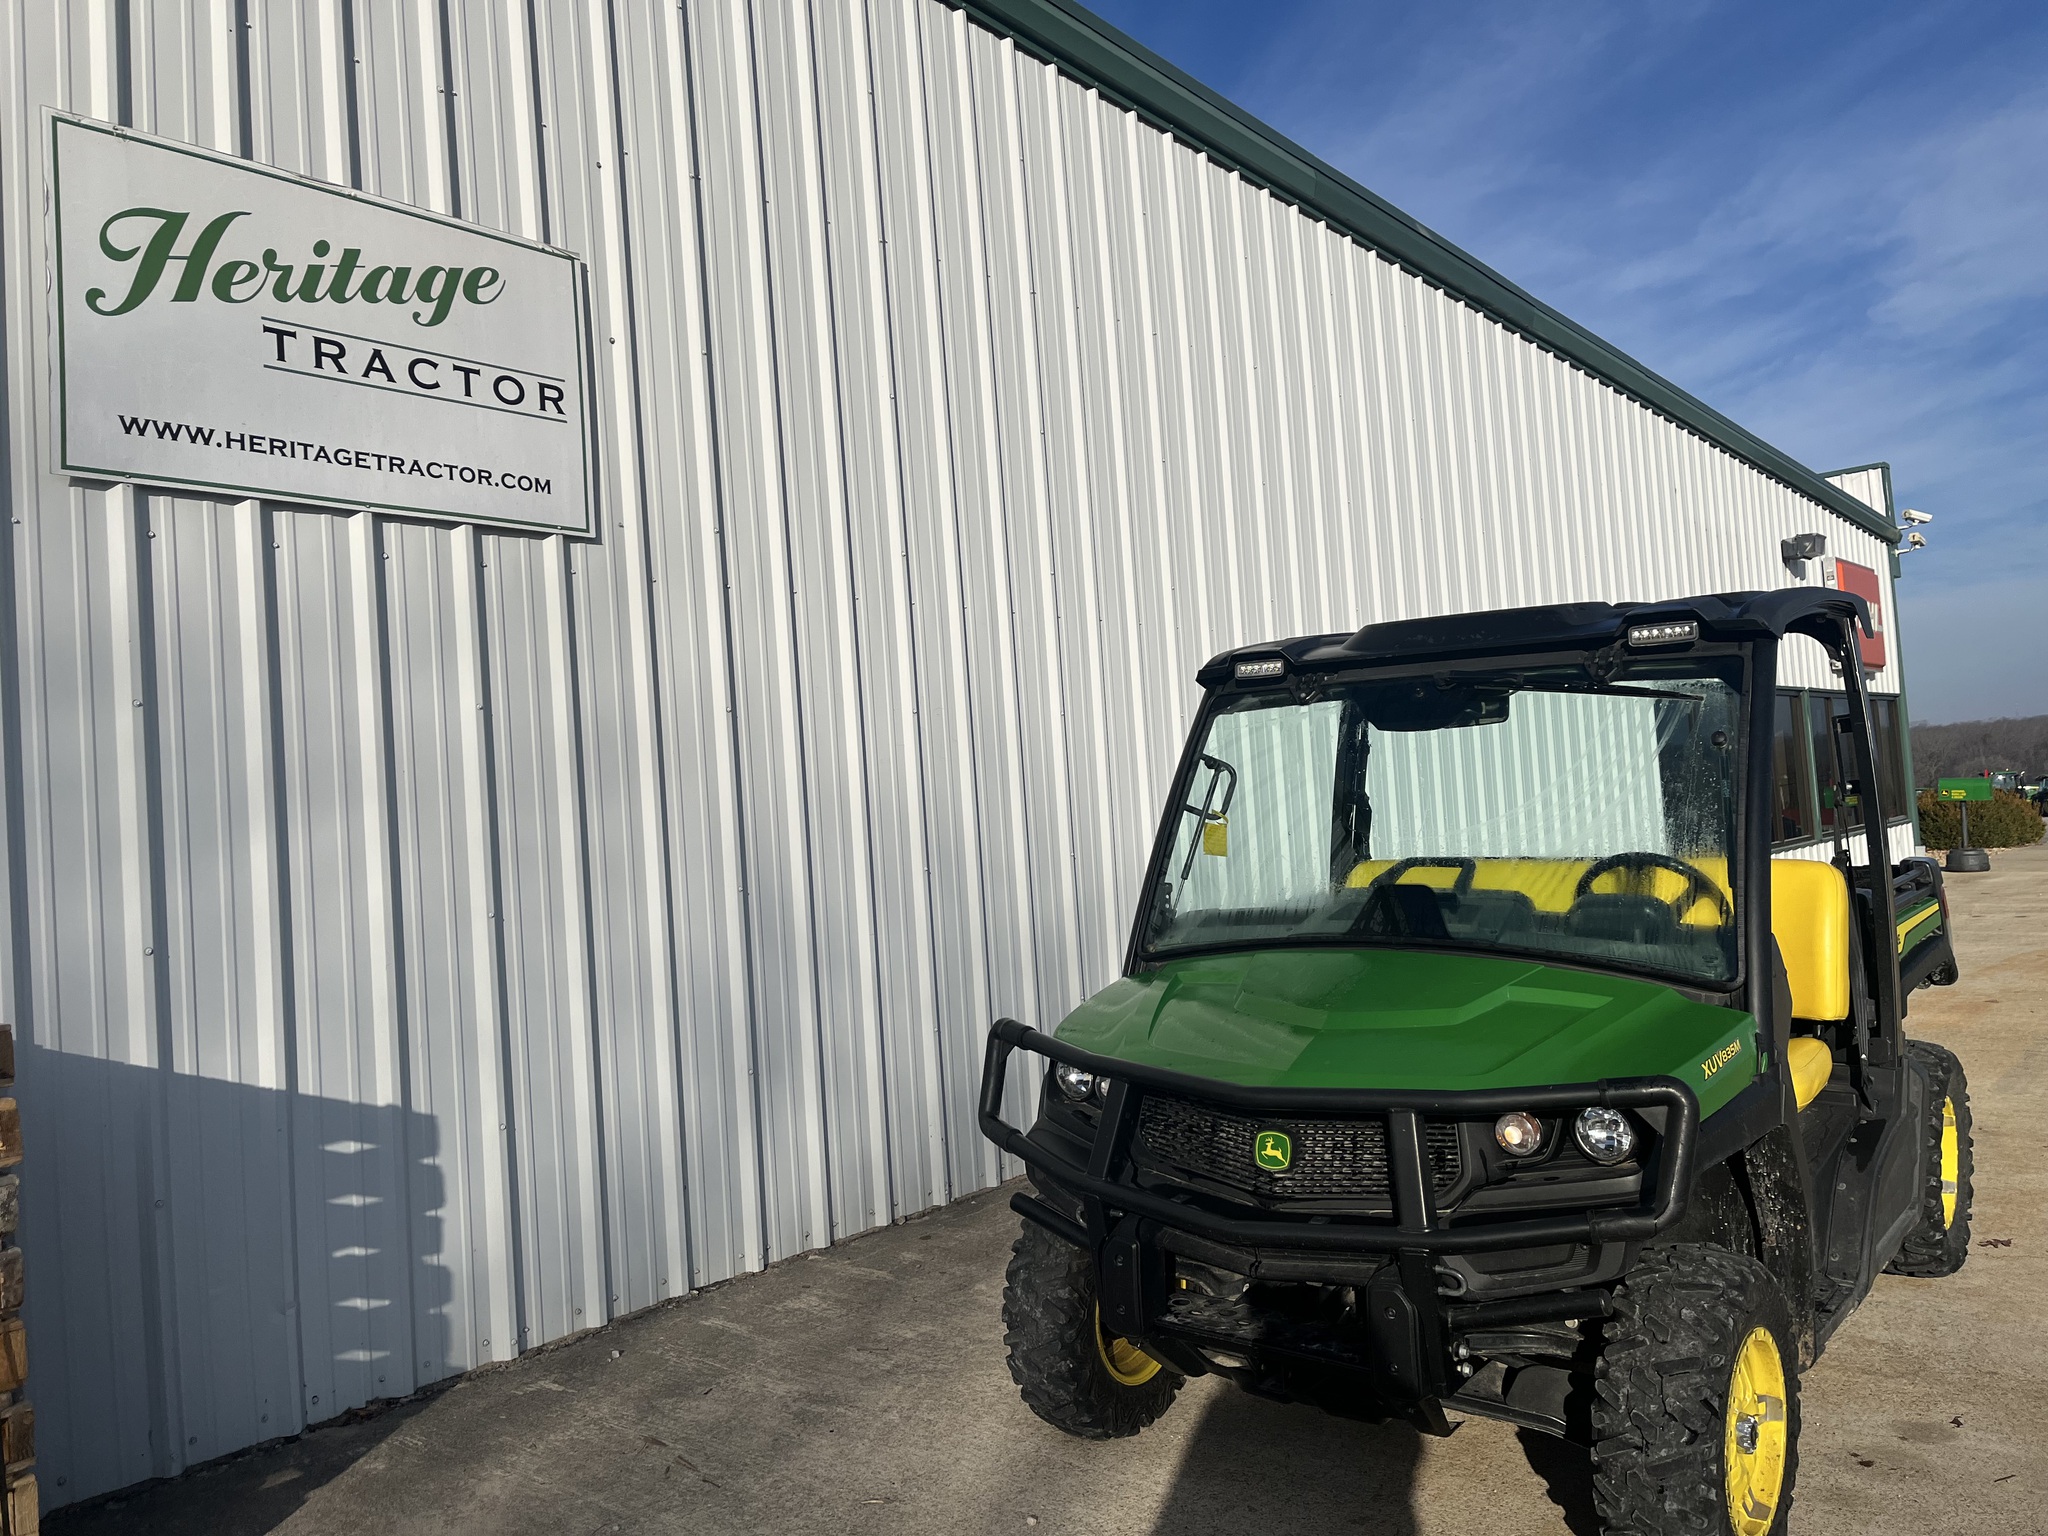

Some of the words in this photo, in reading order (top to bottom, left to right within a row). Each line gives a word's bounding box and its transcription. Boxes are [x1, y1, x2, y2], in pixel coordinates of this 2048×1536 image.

[85, 207, 506, 327] Heritage
[263, 325, 566, 415] TRACTOR
[118, 415, 552, 495] WWW.HERITAGETRACTOR.COM
[1701, 1038, 1742, 1080] XUV835M
